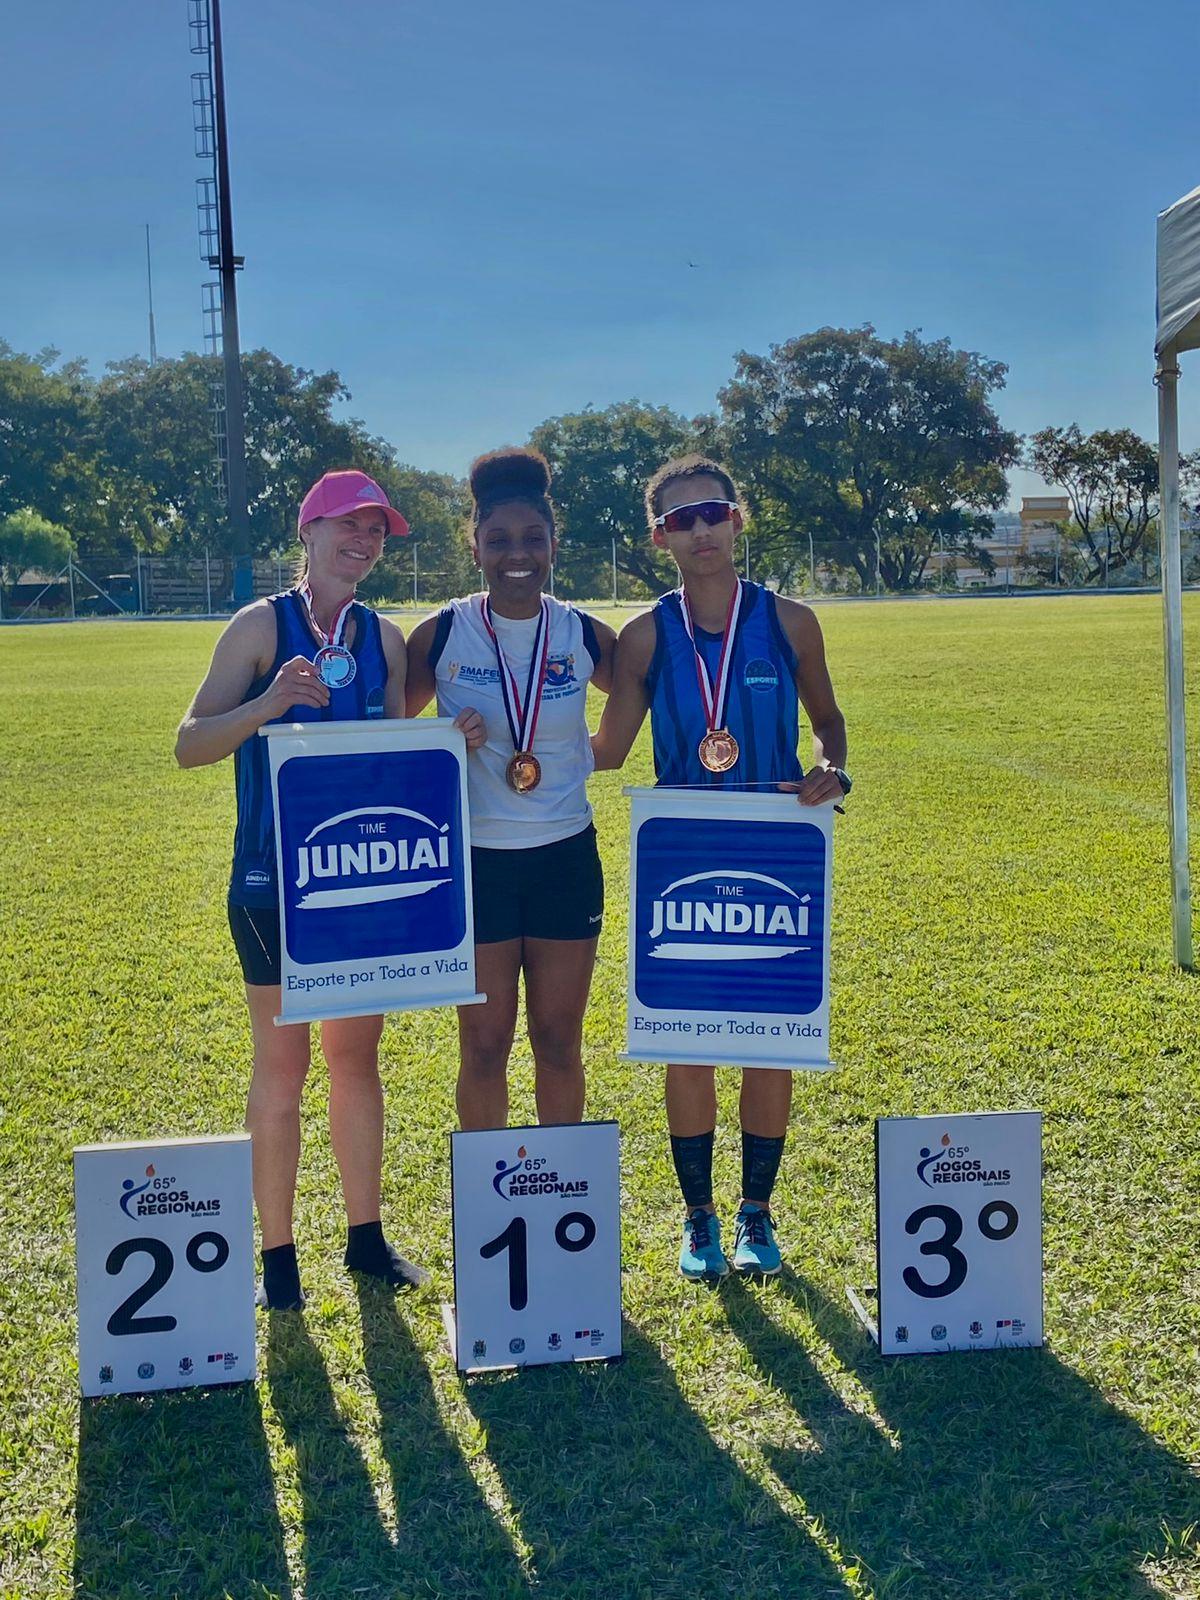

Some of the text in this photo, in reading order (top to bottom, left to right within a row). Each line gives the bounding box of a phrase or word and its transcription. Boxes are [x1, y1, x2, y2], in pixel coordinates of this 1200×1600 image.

[358, 822, 387, 834] TIME
[295, 822, 450, 888] JUNDIAÍ
[715, 885, 744, 897] TIME
[648, 893, 812, 939] JUNDIAÍ
[287, 957, 469, 992] Esporte por Toda a Vida
[633, 1017, 823, 1038] Esporte por Toda a Vida
[932, 1160, 982, 1173] JOGOS
[508, 1171, 559, 1185] JOGOS
[932, 1169, 1011, 1184] REGIONAIS
[509, 1180, 589, 1197] REGIONAIS
[137, 1190, 189, 1205] JOGOS
[137, 1199, 221, 1216] REGIONAIS
